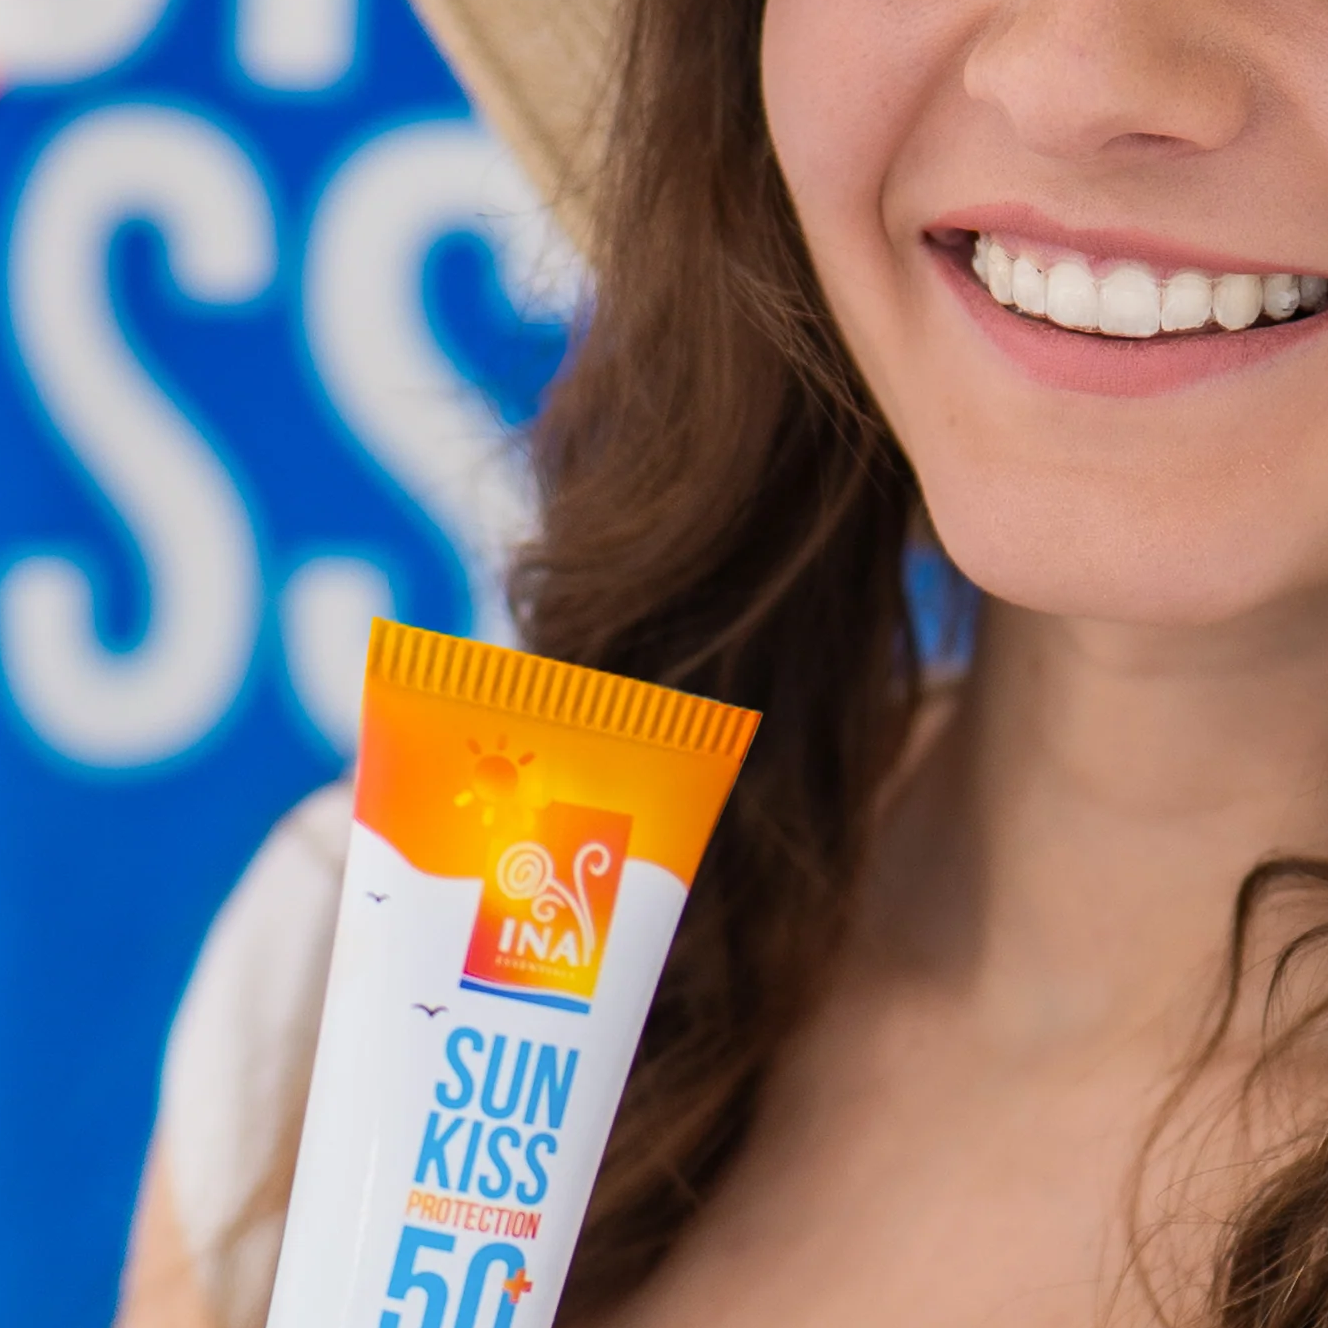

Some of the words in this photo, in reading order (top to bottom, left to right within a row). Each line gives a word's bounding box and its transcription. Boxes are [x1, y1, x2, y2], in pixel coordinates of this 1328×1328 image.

[498, 917, 578, 967] INA
[435, 1026, 580, 1130] SUN
[413, 1111, 557, 1206] KISS
[405, 1189, 542, 1239] PROTECTION
